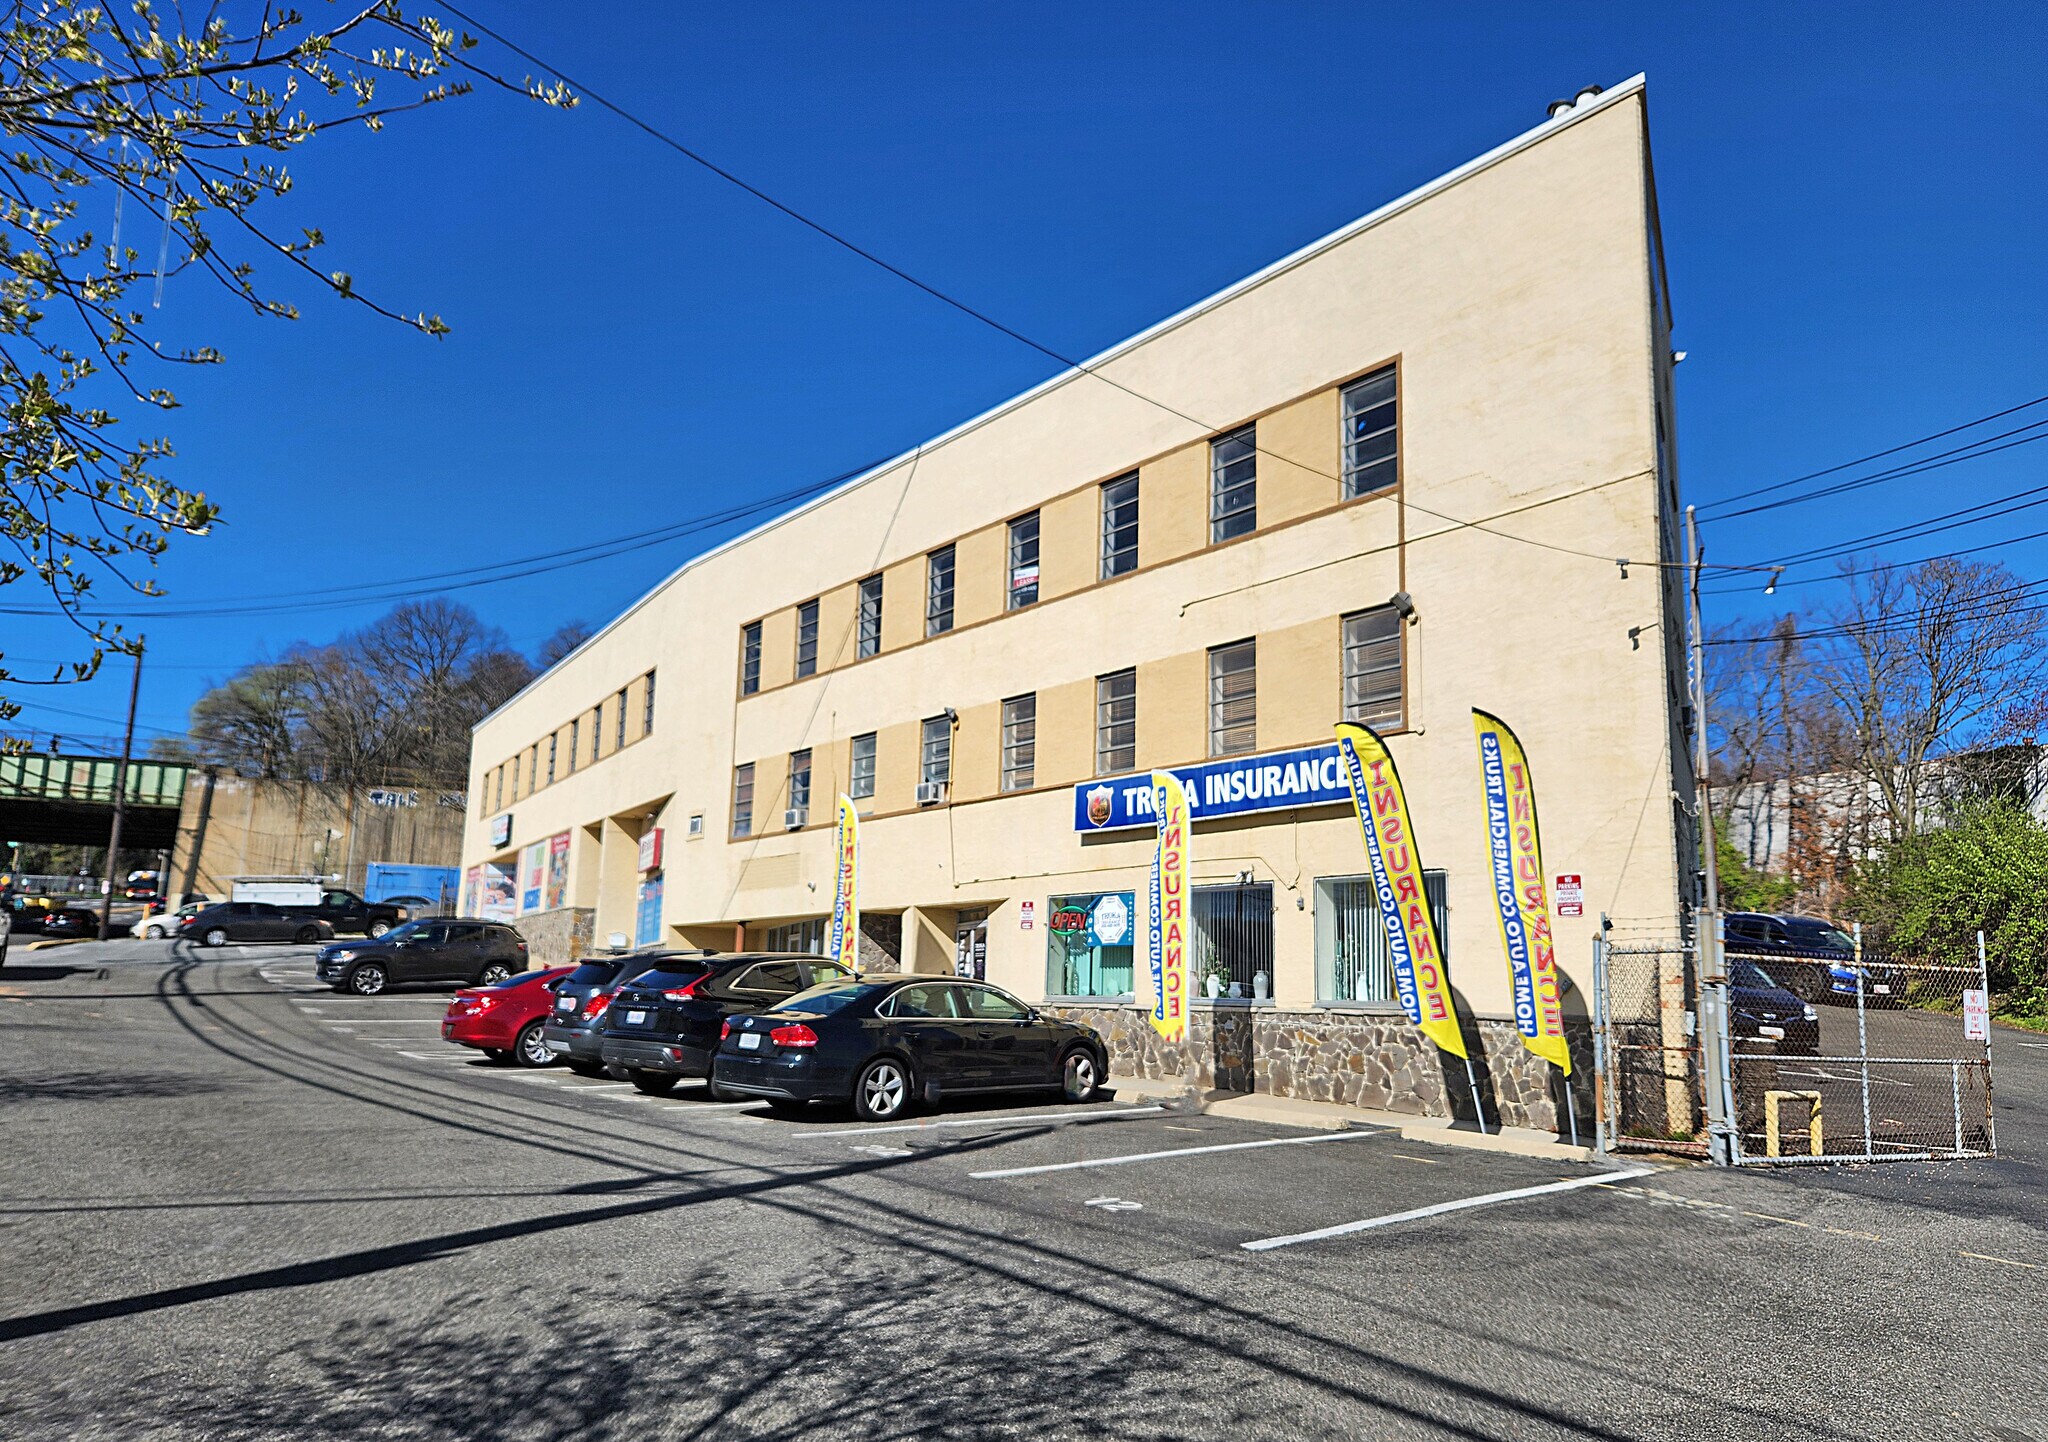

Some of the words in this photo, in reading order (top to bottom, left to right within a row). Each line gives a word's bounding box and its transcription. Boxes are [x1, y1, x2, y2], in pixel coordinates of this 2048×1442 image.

[1206, 758, 1351, 805] INSURANCE
[1558, 882, 1580, 890] PARKING
[1050, 911, 1087, 929] OPEN
